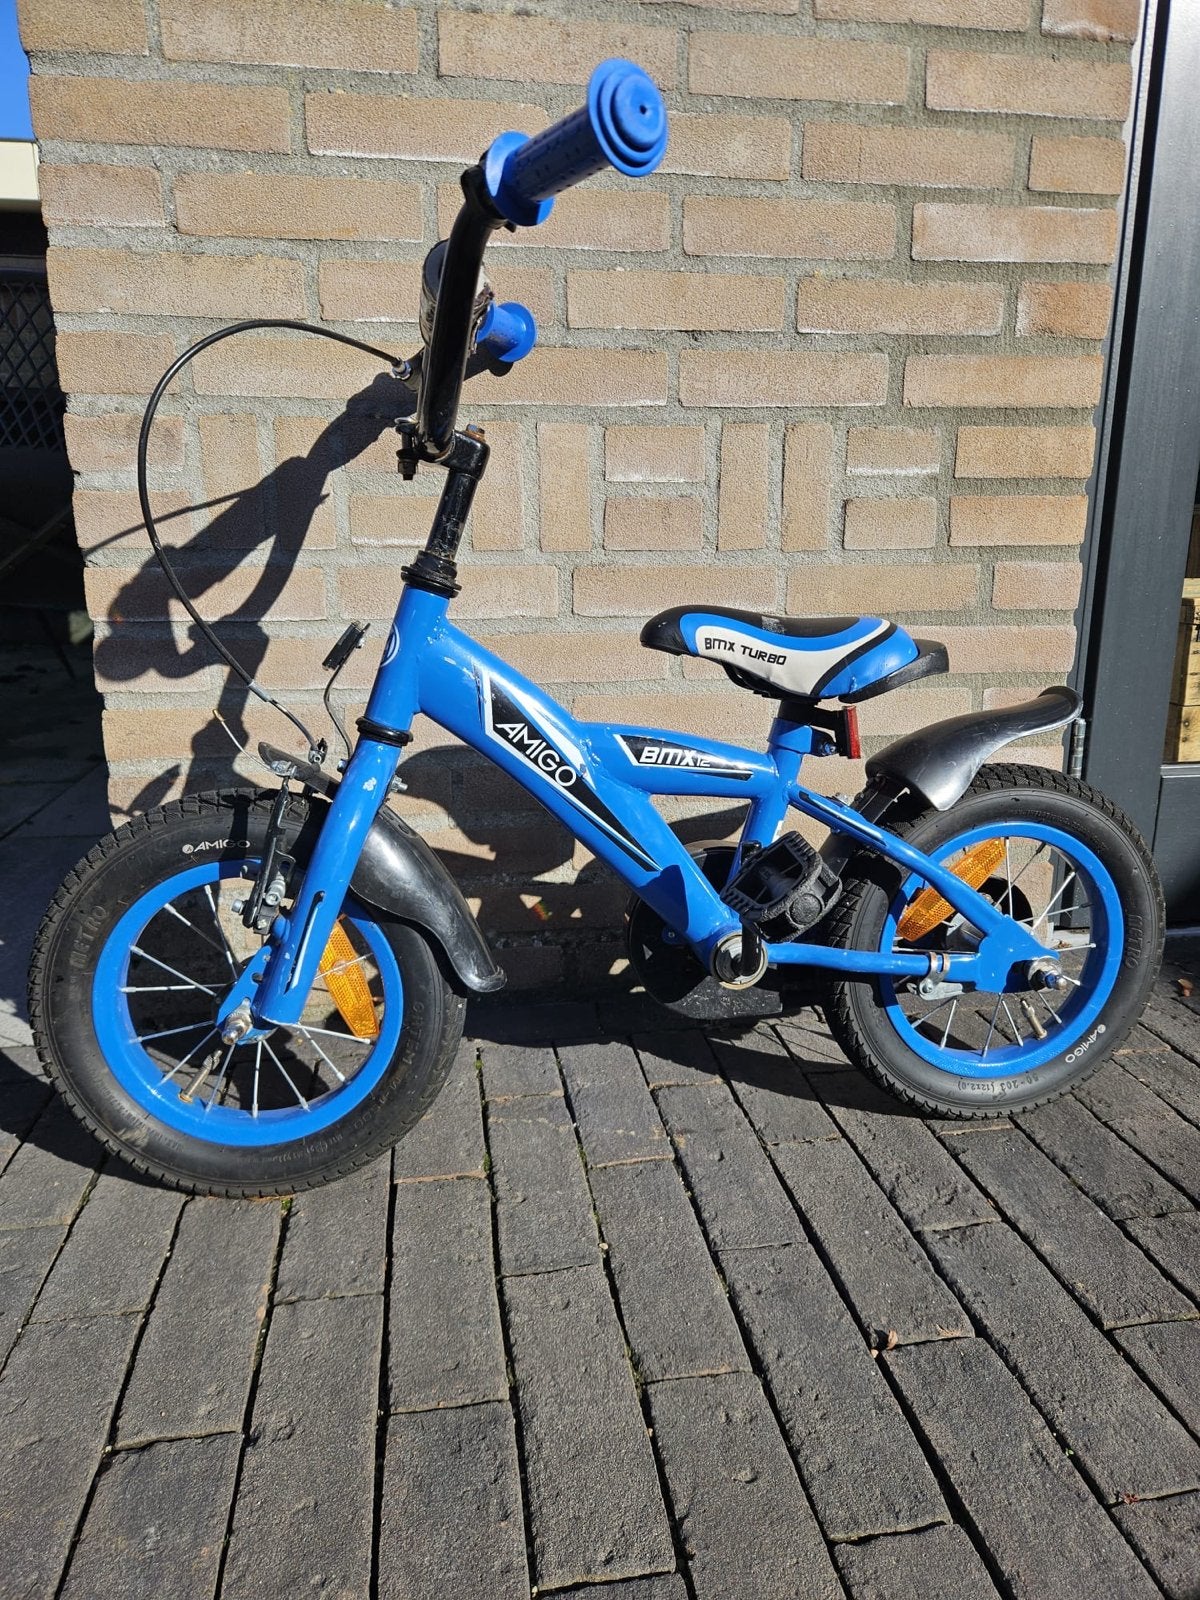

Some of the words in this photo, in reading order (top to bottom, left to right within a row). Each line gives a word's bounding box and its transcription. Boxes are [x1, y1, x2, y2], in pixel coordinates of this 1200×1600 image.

[704, 637, 736, 652] BMX
[740, 644, 788, 666] TURBO
[494, 722, 577, 787] AMIGO
[193, 839, 251, 852] AMIGO
[1064, 1028, 1099, 1063] AMIGO
